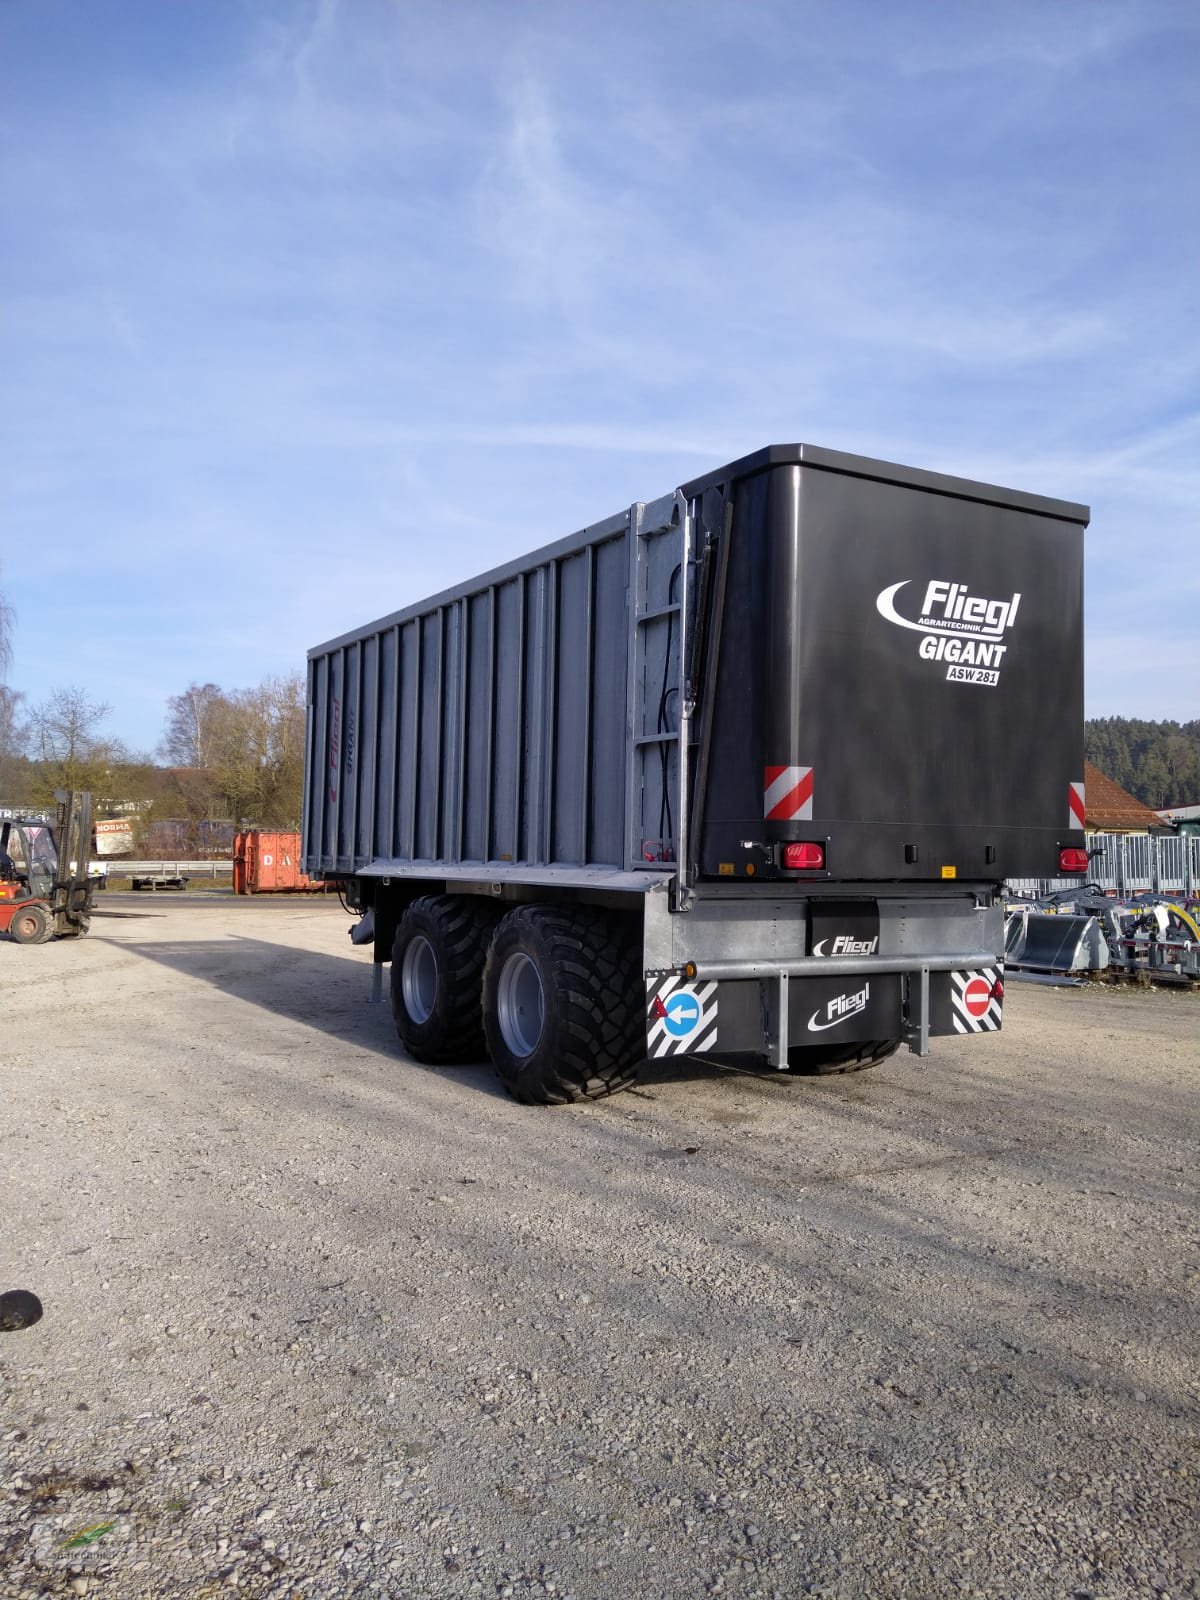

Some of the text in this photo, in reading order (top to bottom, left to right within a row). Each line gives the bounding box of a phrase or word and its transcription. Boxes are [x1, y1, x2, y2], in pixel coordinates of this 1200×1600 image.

[921, 580, 1021, 635] Fliegl
[918, 617, 982, 632] AGRARTECHNIK
[918, 635, 1007, 667] GIGANT
[949, 667, 996, 684] ASW 281
[831, 935, 878, 956] Fliegl
[827, 982, 870, 1020] Fliegl
